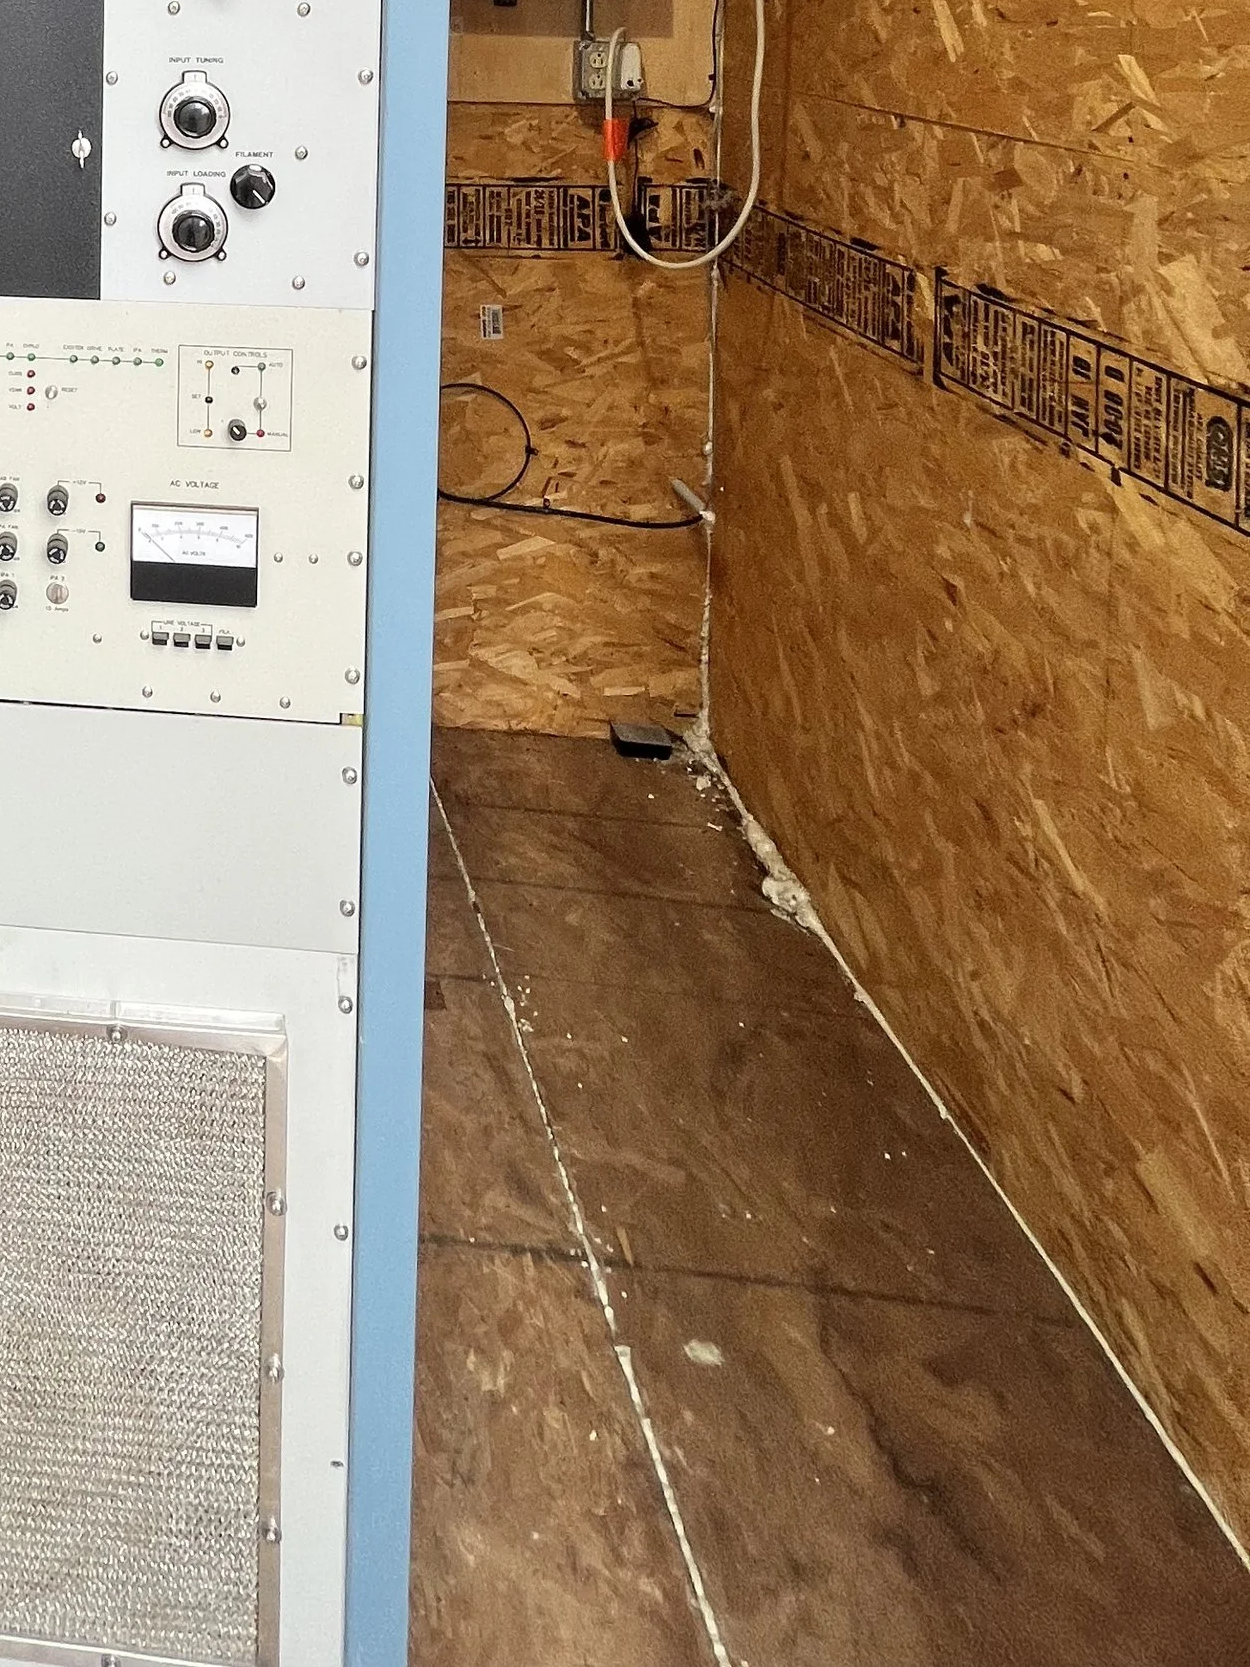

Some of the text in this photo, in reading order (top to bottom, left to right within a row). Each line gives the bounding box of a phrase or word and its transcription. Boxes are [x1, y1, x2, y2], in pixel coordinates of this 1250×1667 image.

[193, 170, 226, 178] LOADING
[232, 350, 268, 359] CONTROLS
[169, 479, 220, 489] AC VOLTAGE
